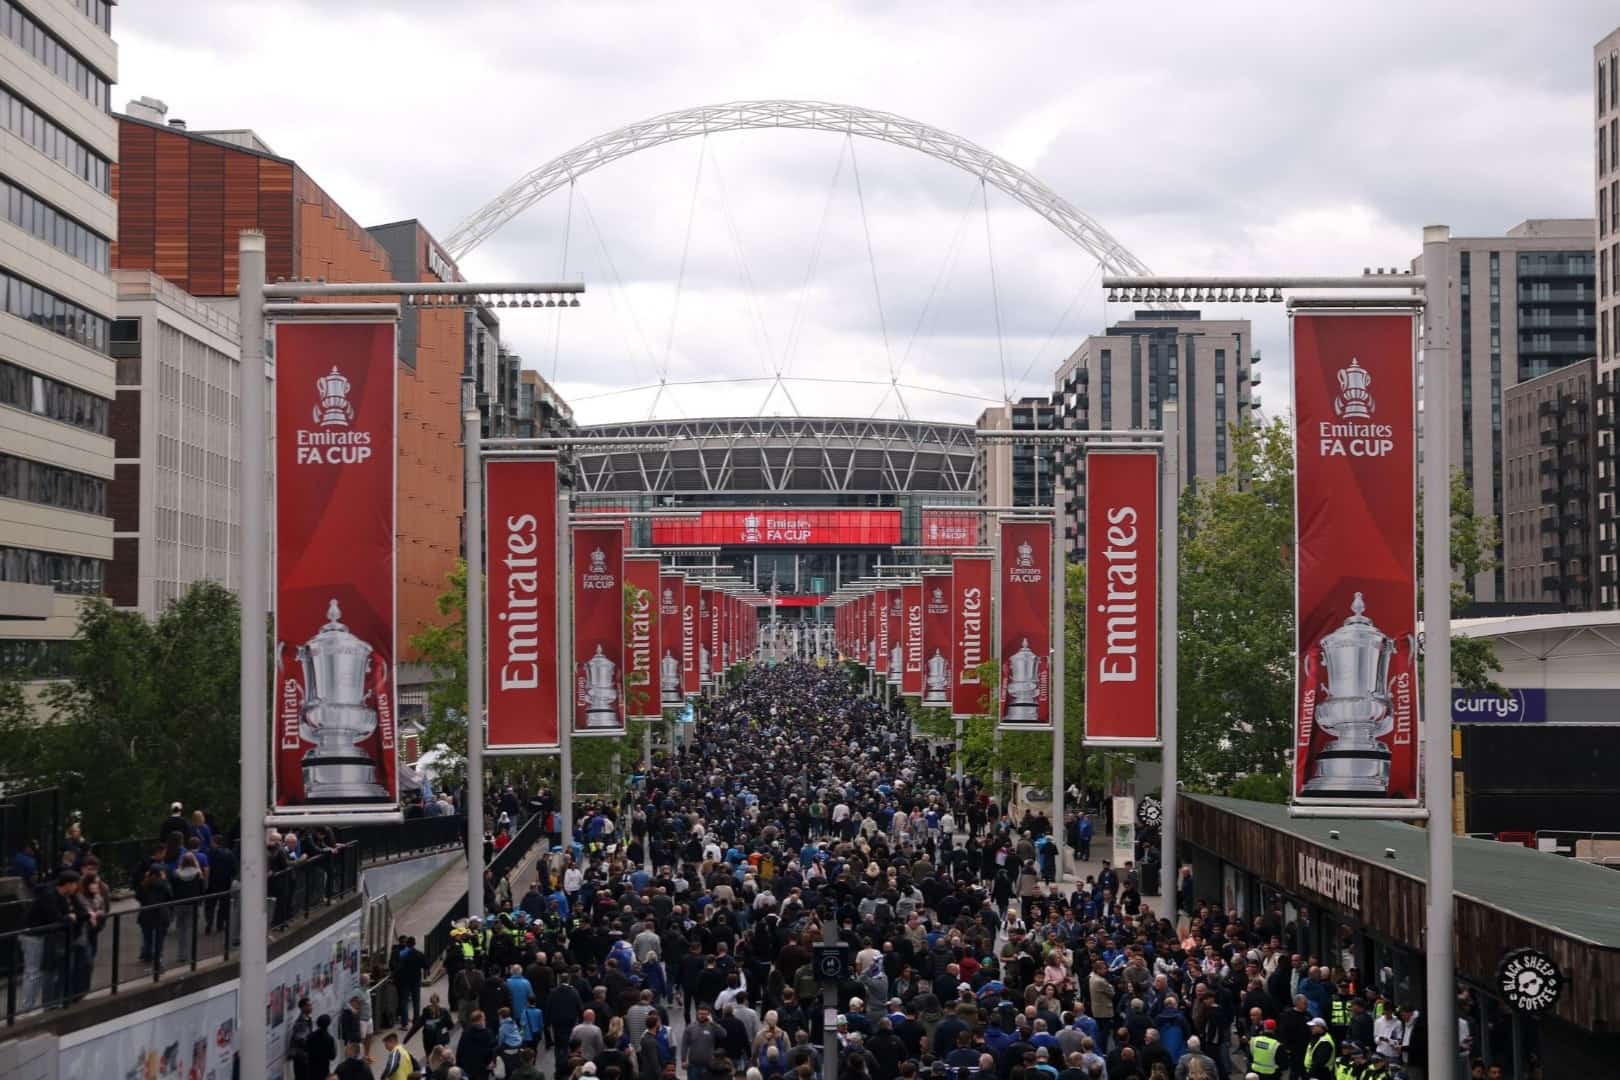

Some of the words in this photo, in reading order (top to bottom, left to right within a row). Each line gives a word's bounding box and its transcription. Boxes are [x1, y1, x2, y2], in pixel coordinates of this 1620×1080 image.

[297, 429, 371, 445] Emirates
[1320, 422, 1393, 437] Emirates
[1320, 440, 1347, 456] FA
[1349, 440, 1394, 456] CUP
[297, 447, 323, 464] FA
[326, 446, 372, 464] CUP
[767, 531, 782, 540] FA
[784, 530, 811, 540] CUP
[498, 513, 538, 691] Emirates
[1097, 506, 1137, 683] Emirates
[906, 605, 921, 672] Emirates
[281, 679, 300, 750] Emirates
[378, 693, 394, 749] Emirates
[1298, 690, 1316, 747] Emirates
[1393, 672, 1411, 745] Emirates
[1454, 698, 1519, 717] currys
[1335, 867, 1360, 911] COFFEE
[1503, 960, 1525, 991] BLACK
[1523, 955, 1555, 977] SHEEP
[1518, 986, 1557, 1010] COFFEE
